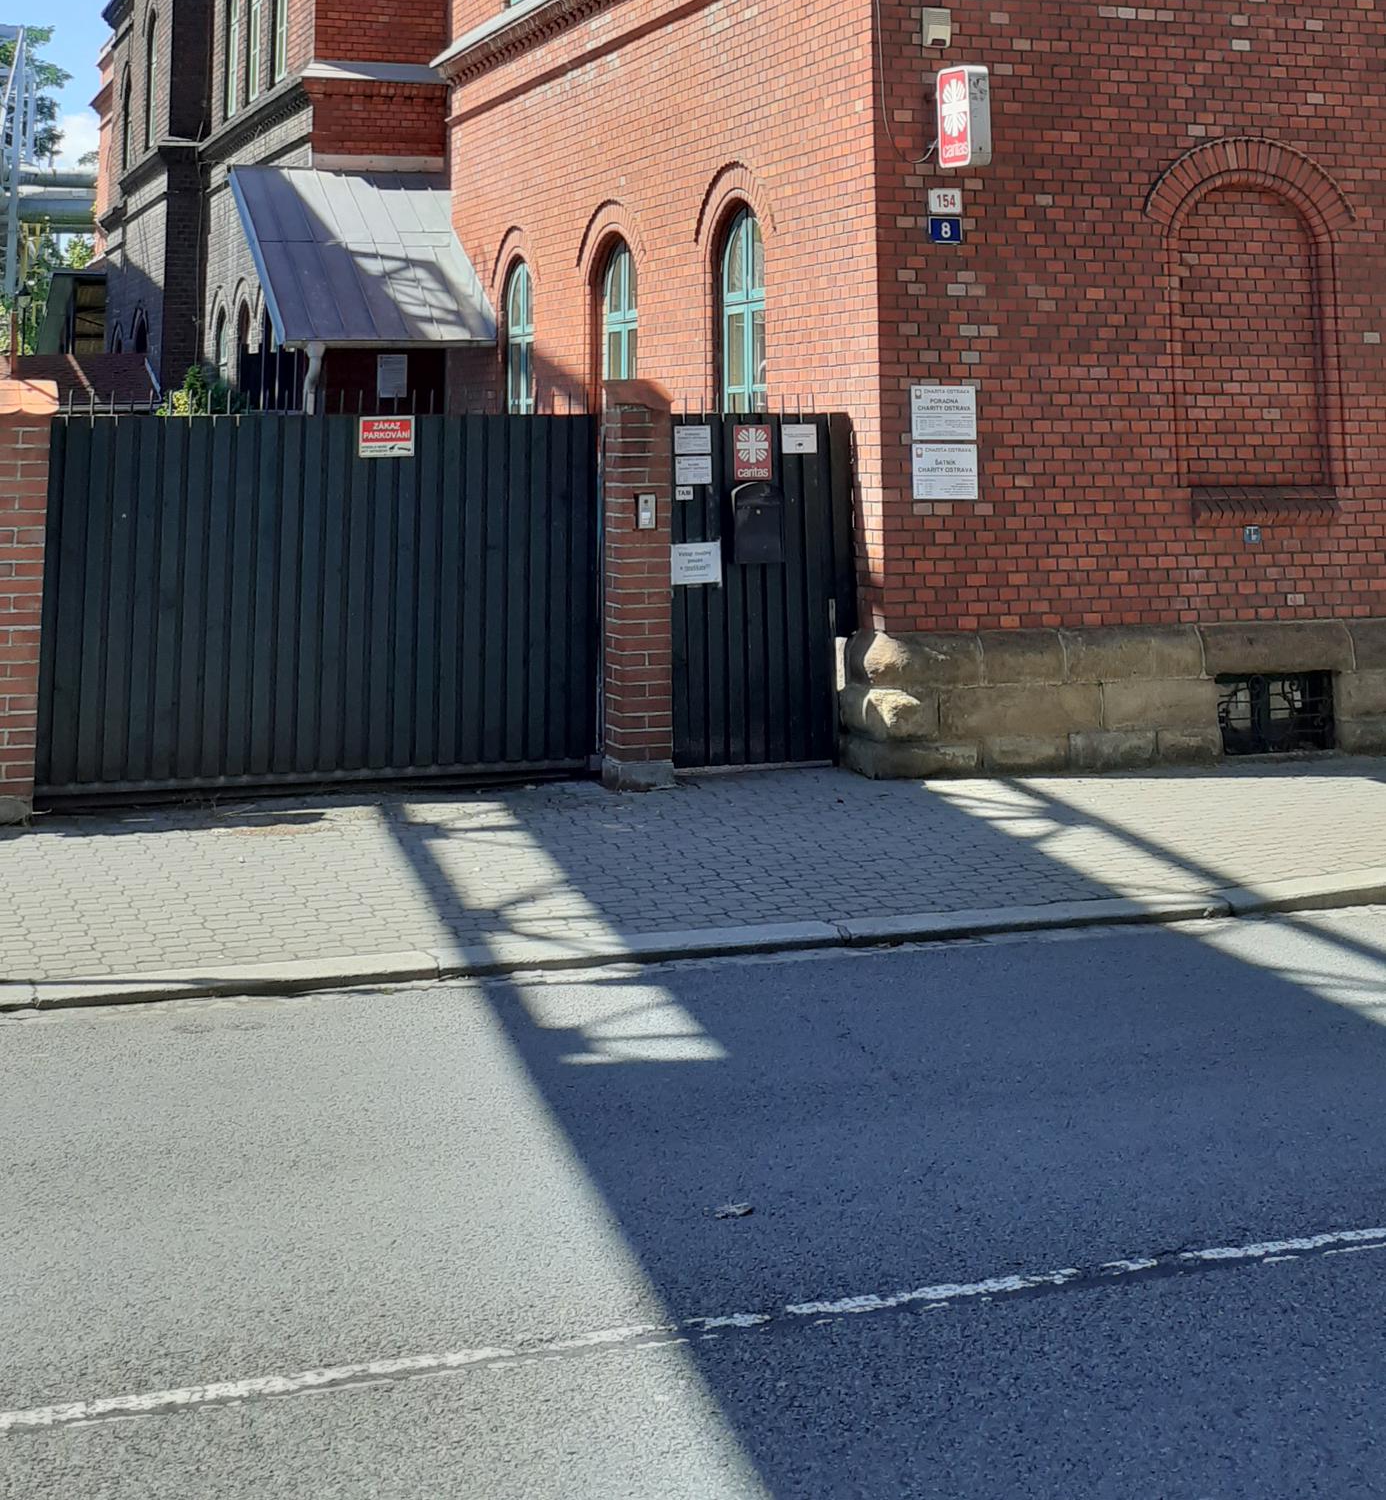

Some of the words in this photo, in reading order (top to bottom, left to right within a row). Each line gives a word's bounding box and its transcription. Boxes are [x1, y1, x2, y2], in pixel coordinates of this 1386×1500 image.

[942, 140, 969, 159] caritas
[937, 195, 956, 208] 154
[941, 222, 951, 238] 8
[373, 421, 400, 430] ZÁKAZ
[363, 429, 410, 439] PARKOVÁNÍ
[737, 465, 769, 478] caritas
